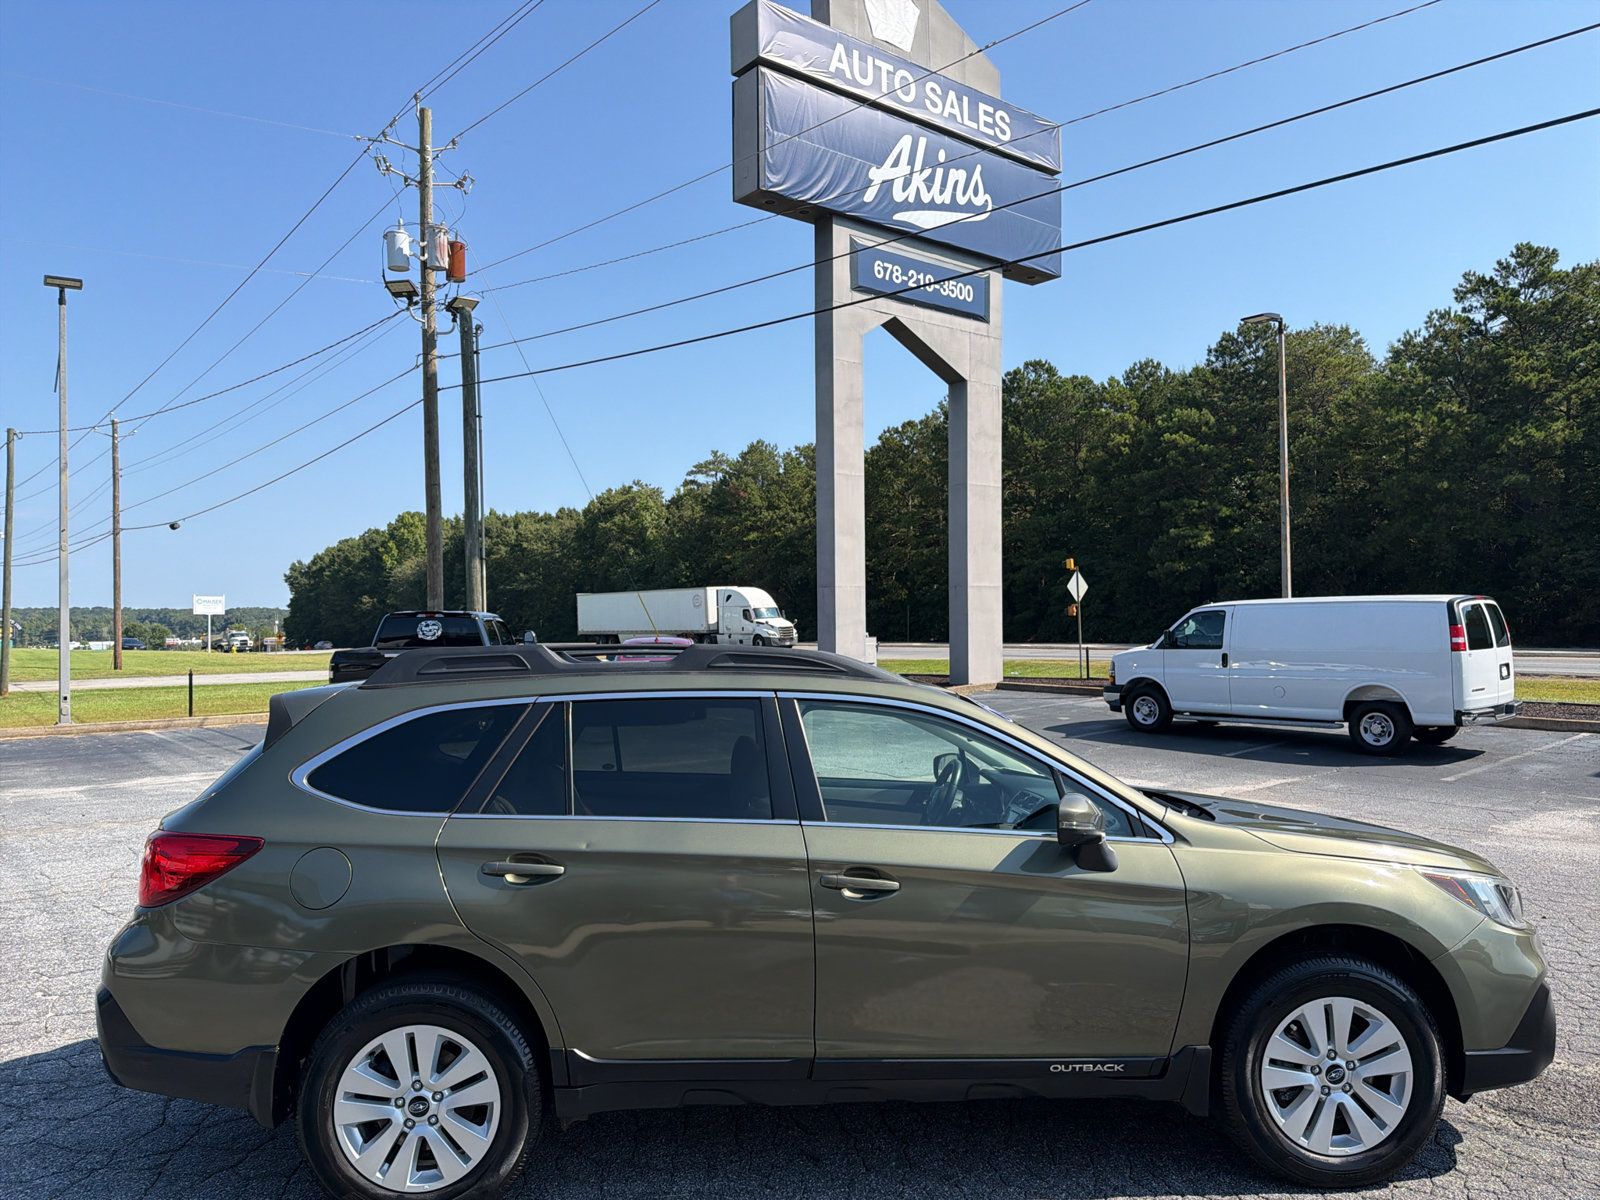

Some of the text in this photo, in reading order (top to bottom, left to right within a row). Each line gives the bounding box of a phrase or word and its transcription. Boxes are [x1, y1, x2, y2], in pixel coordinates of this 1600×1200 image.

[828, 42, 1012, 141] AUTO SALES
[863, 134, 992, 208] Akins
[1050, 1063, 1125, 1073] OUTBACK
